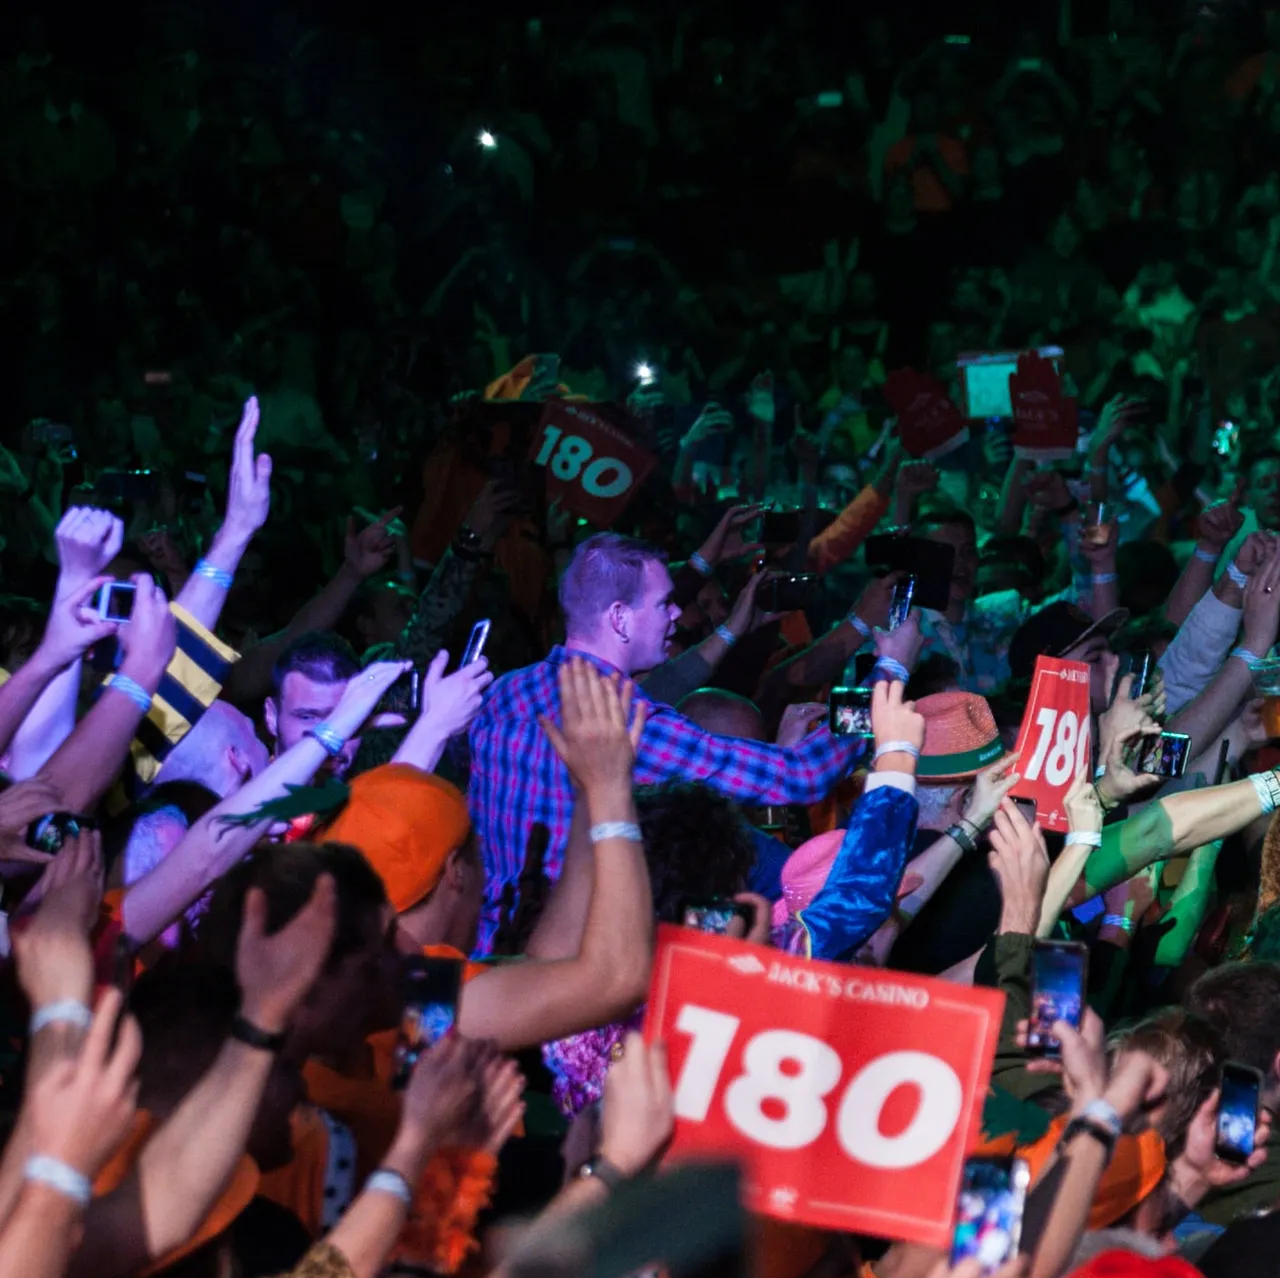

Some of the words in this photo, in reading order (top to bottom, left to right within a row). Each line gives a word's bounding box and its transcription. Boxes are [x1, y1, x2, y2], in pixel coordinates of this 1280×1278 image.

[535, 424, 633, 497] 180
[767, 962, 842, 996] JACK'S
[847, 979, 930, 1009] CASINO
[674, 1003, 963, 1169] 180
